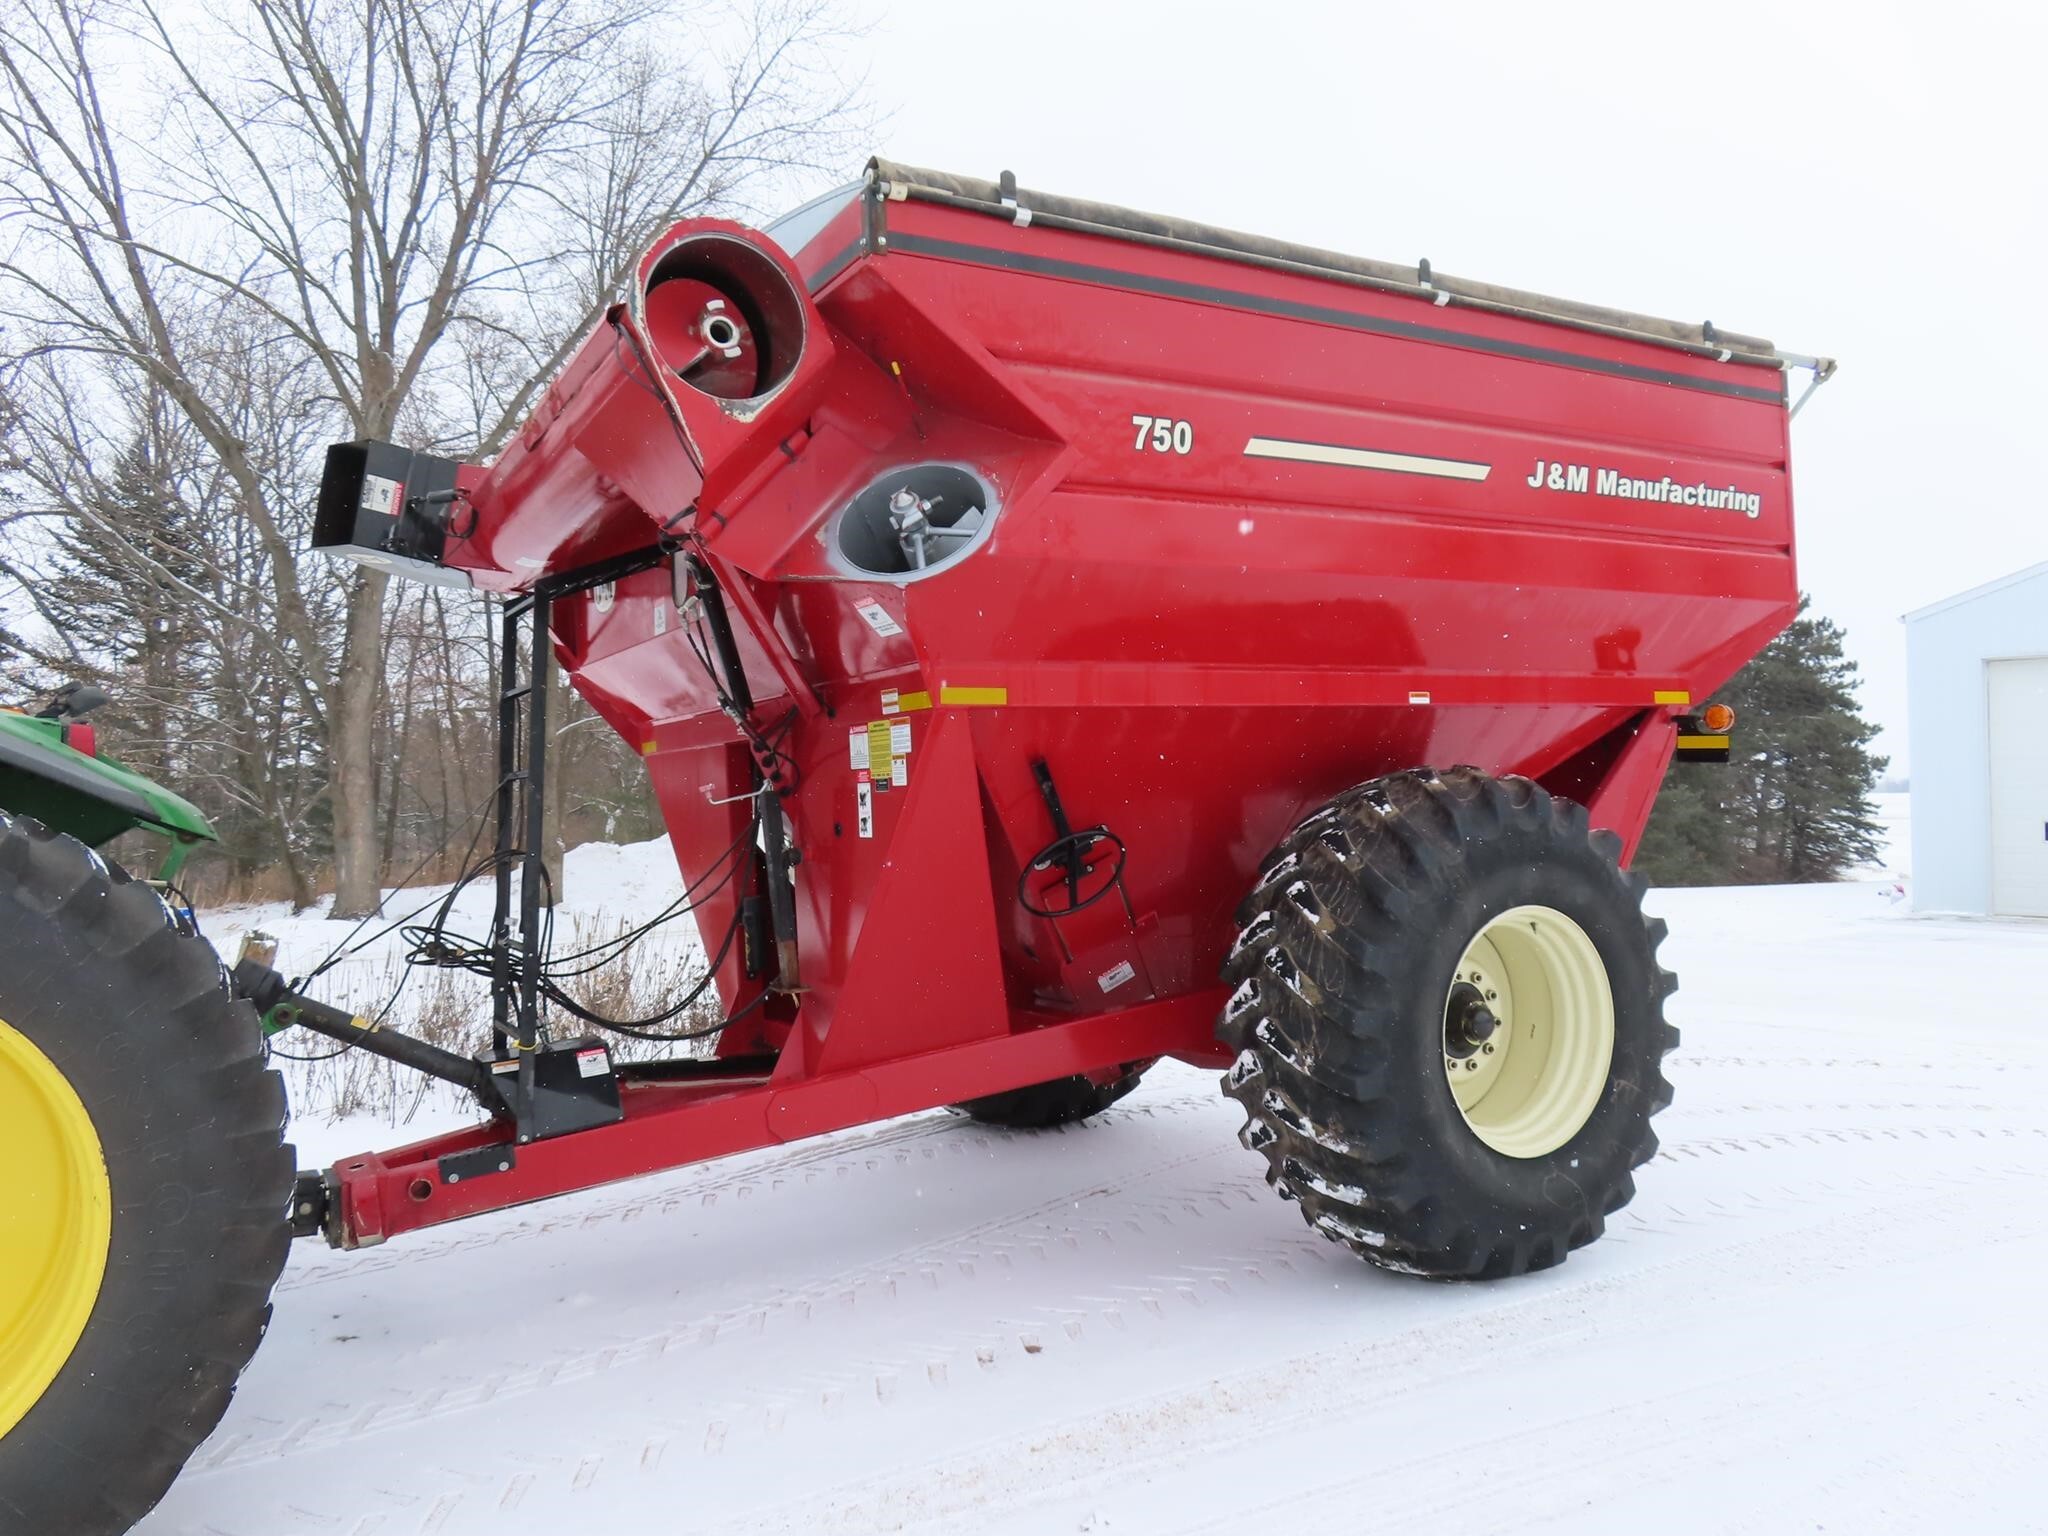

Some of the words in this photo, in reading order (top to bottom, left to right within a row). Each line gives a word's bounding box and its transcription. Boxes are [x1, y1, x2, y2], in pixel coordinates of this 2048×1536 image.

[1131, 414, 1193, 455] 750
[1526, 460, 1590, 494] J&M
[1595, 467, 1762, 519] Manufacturing
